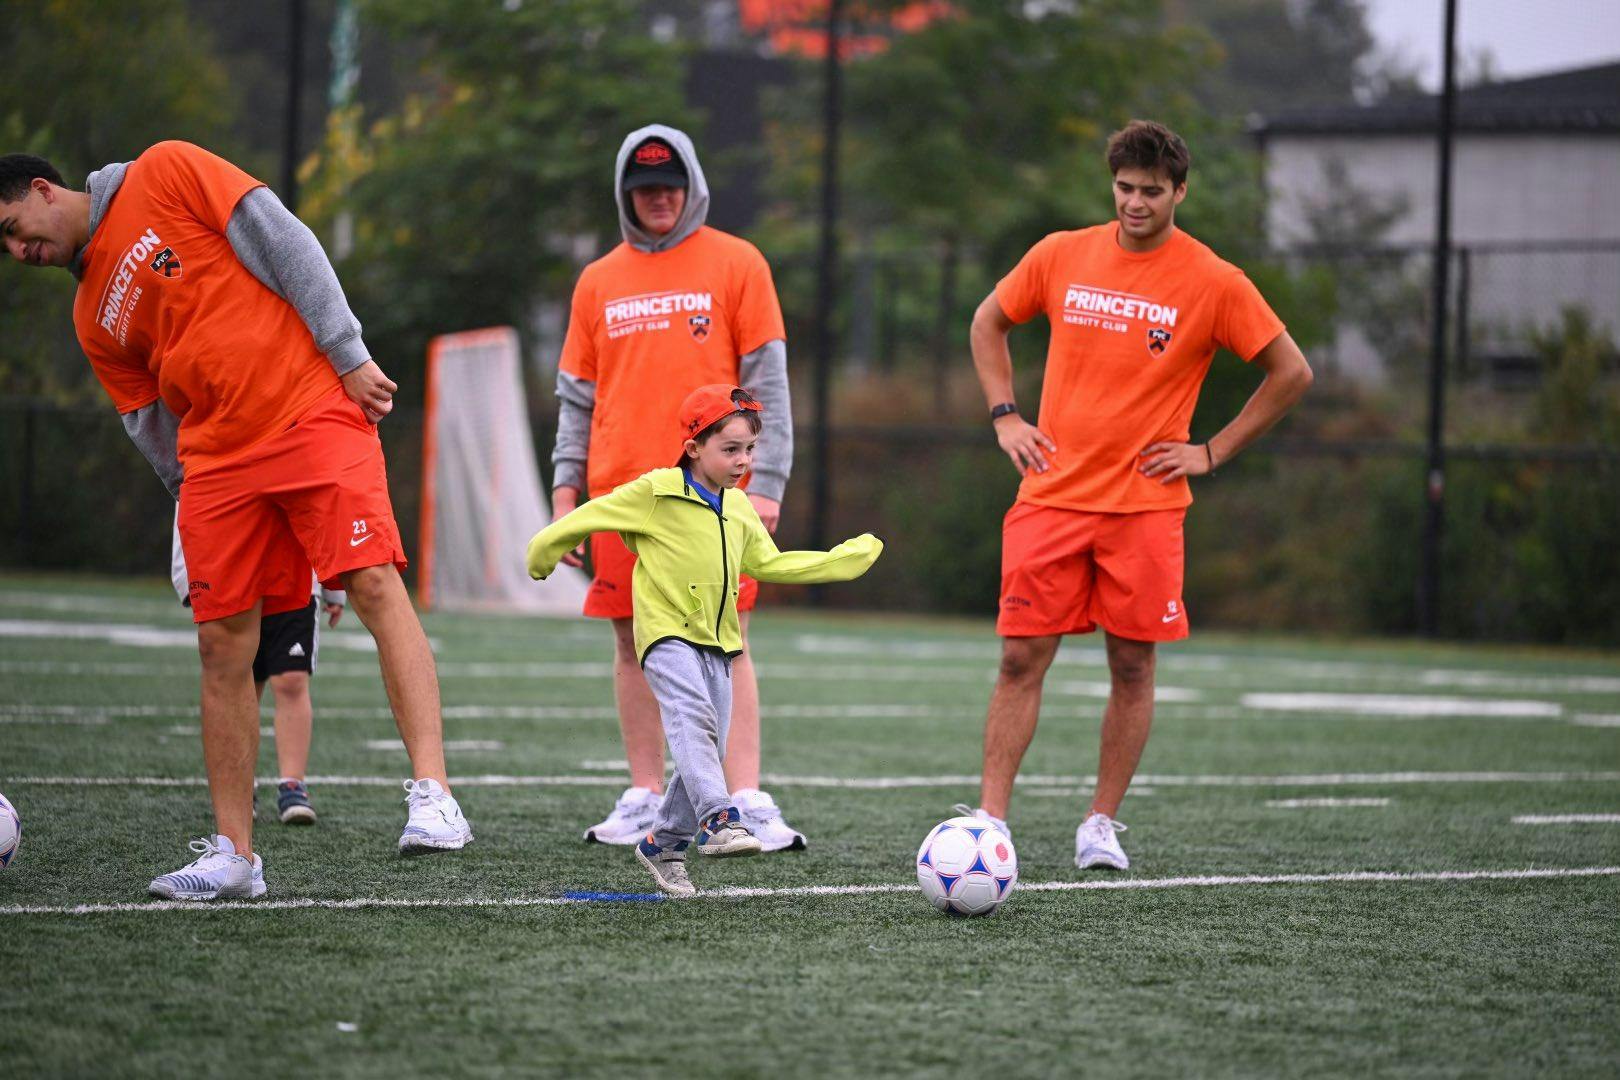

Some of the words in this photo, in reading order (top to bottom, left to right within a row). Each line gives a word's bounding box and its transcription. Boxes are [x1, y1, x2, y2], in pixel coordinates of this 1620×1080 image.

[155, 252, 169, 267] PVC
[101, 228, 161, 336] PRINCETON
[128, 286, 143, 311] CLUB
[605, 293, 711, 325] PRINCETON
[1064, 288, 1178, 327] PRINCETON
[608, 323, 643, 339] VARSITY
[646, 319, 670, 331] CLUB
[1063, 314, 1099, 328] VARSITY
[1102, 320, 1128, 333] CLUB
[352, 519, 367, 535] 23
